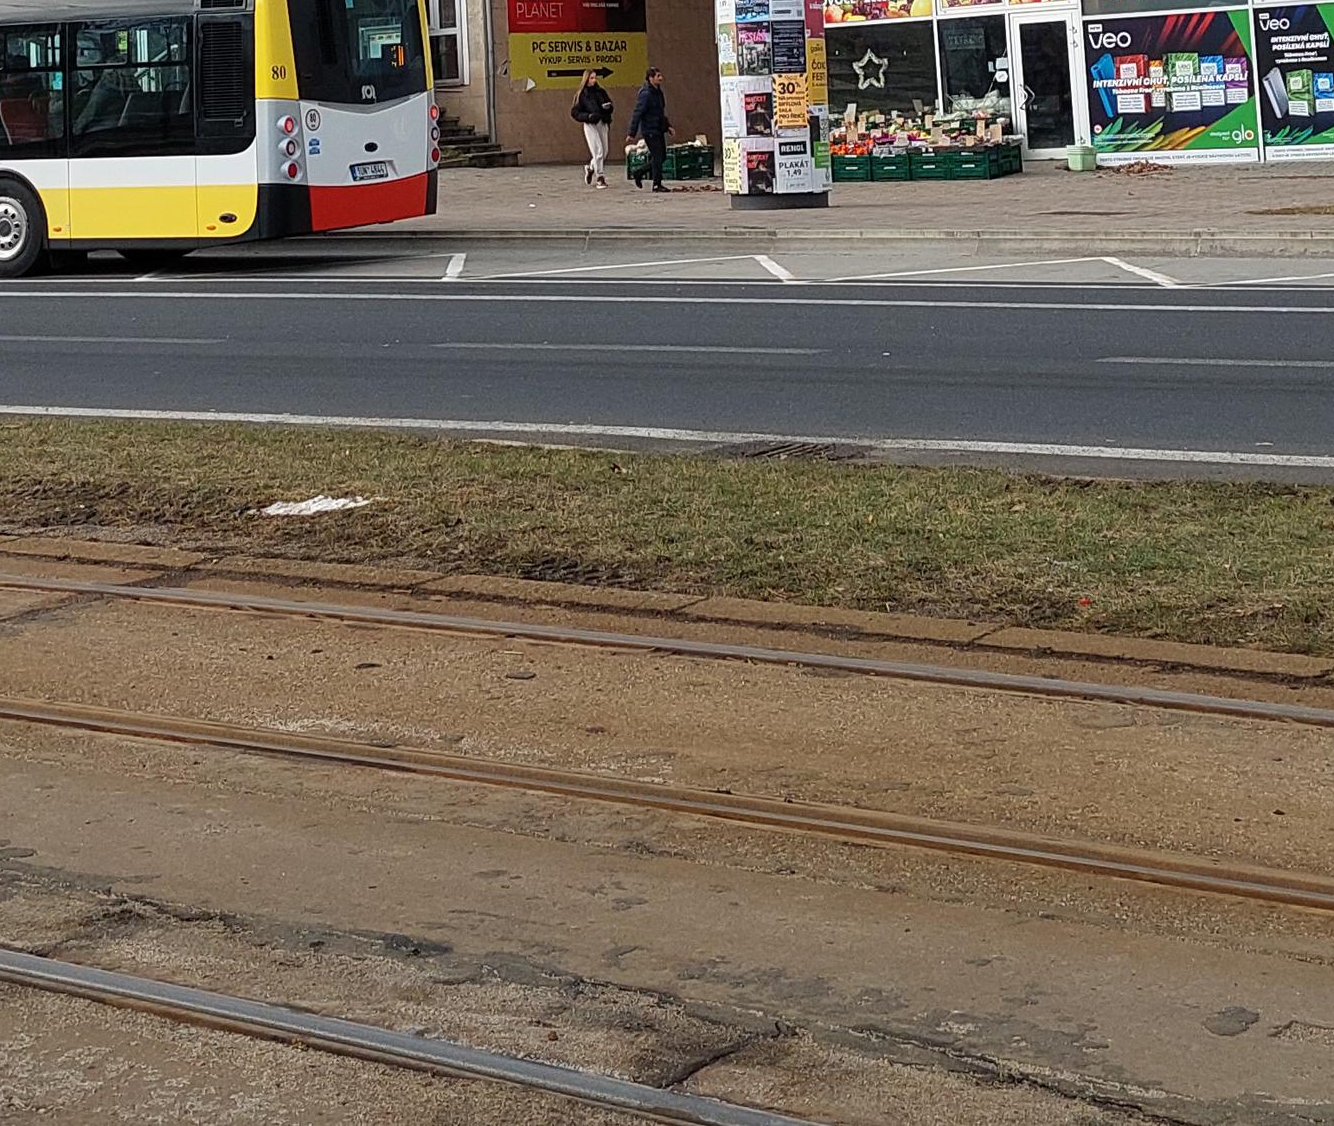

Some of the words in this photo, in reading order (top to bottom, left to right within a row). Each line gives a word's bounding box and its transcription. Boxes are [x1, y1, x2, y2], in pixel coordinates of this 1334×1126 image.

[516, 2, 563, 18] PLANET
[1260, 18, 1290, 31] veo
[532, 41, 546, 53] PC
[548, 41, 584, 53] SERVIS
[594, 41, 628, 52] BAZAR
[1088, 32, 1131, 49] veo
[539, 56, 563, 65] VÝKUP
[567, 55, 591, 64] SERVIS
[596, 54, 623, 63] PRODEJ
[271, 65, 287, 80] 80
[1092, 76, 1142, 89] INTENZIVNÍ
[1171, 72, 1214, 84] POSÍLENÁ
[1215, 71, 1248, 82] KAPSLÍ
[309, 112, 317, 123] 80
[1232, 123, 1255, 144] glo
[779, 159, 810, 170] PLAKÁT
